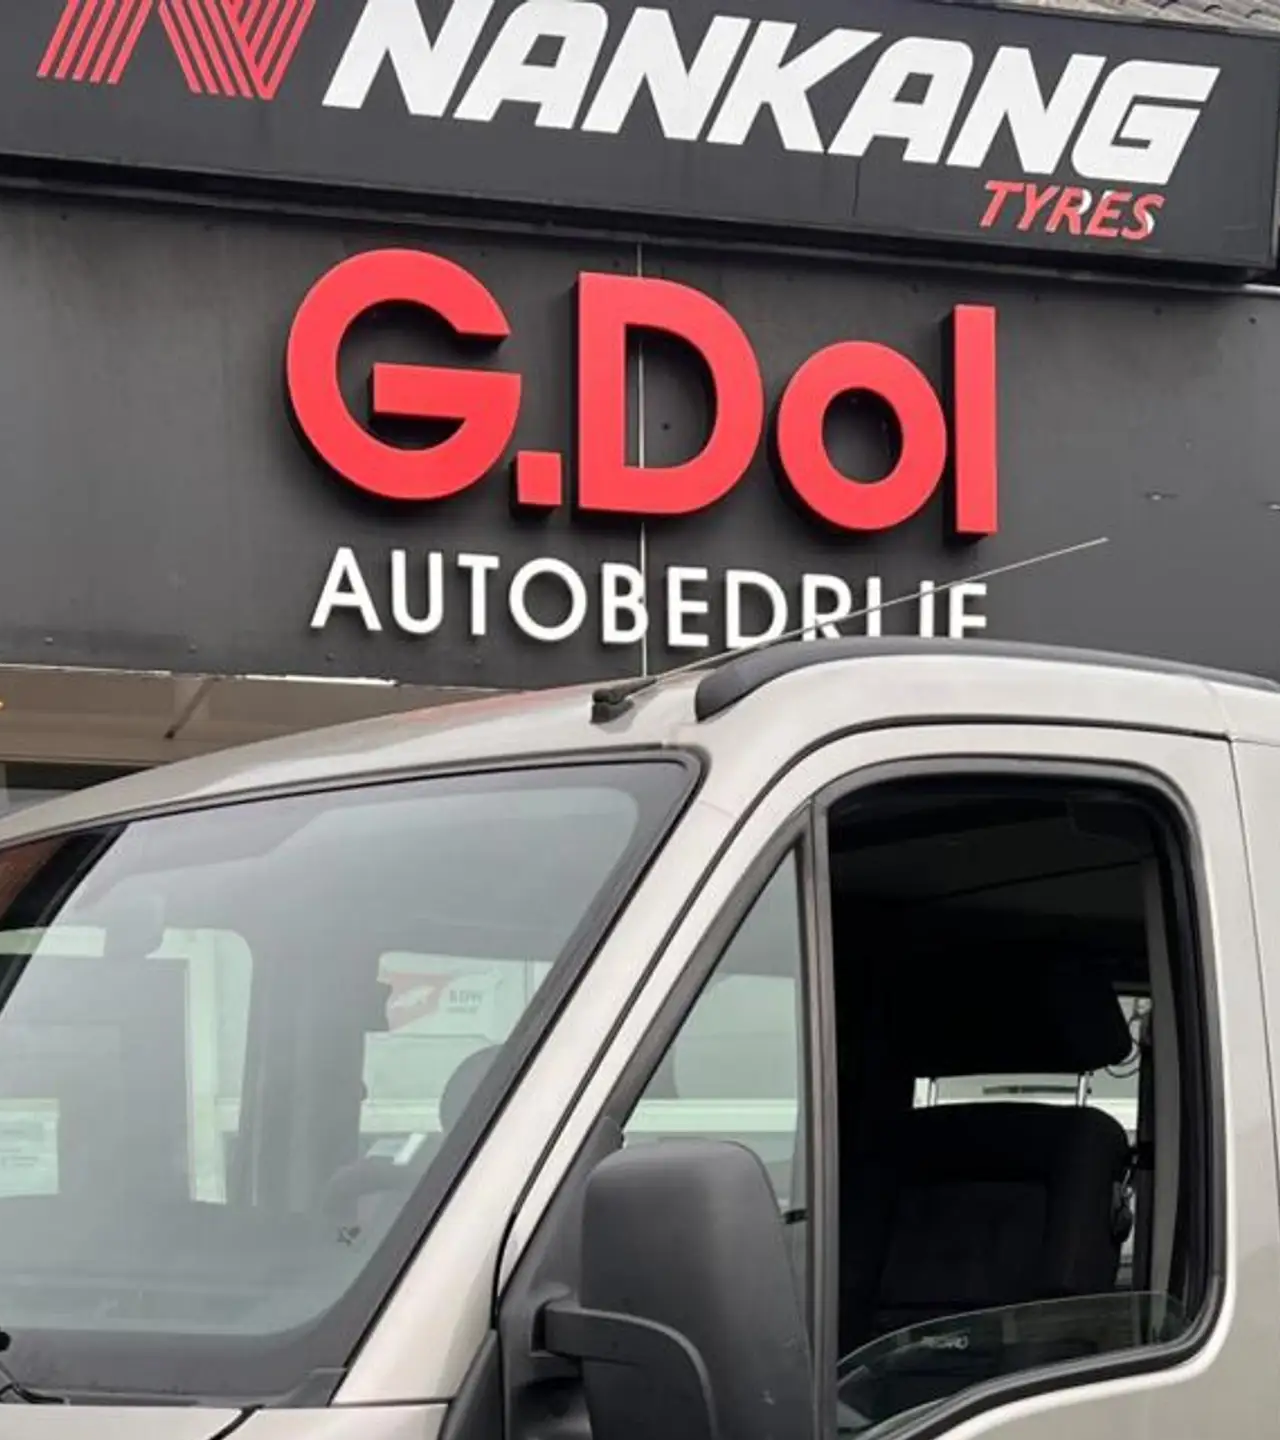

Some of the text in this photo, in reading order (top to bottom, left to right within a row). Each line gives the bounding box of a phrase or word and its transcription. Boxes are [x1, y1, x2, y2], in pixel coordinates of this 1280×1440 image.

[322, 0, 1220, 184] NANKANG
[979, 179, 1165, 241] TYRES
[287, 248, 997, 535] G.Dol
[311, 546, 988, 650] AUTOBEDRIJF
